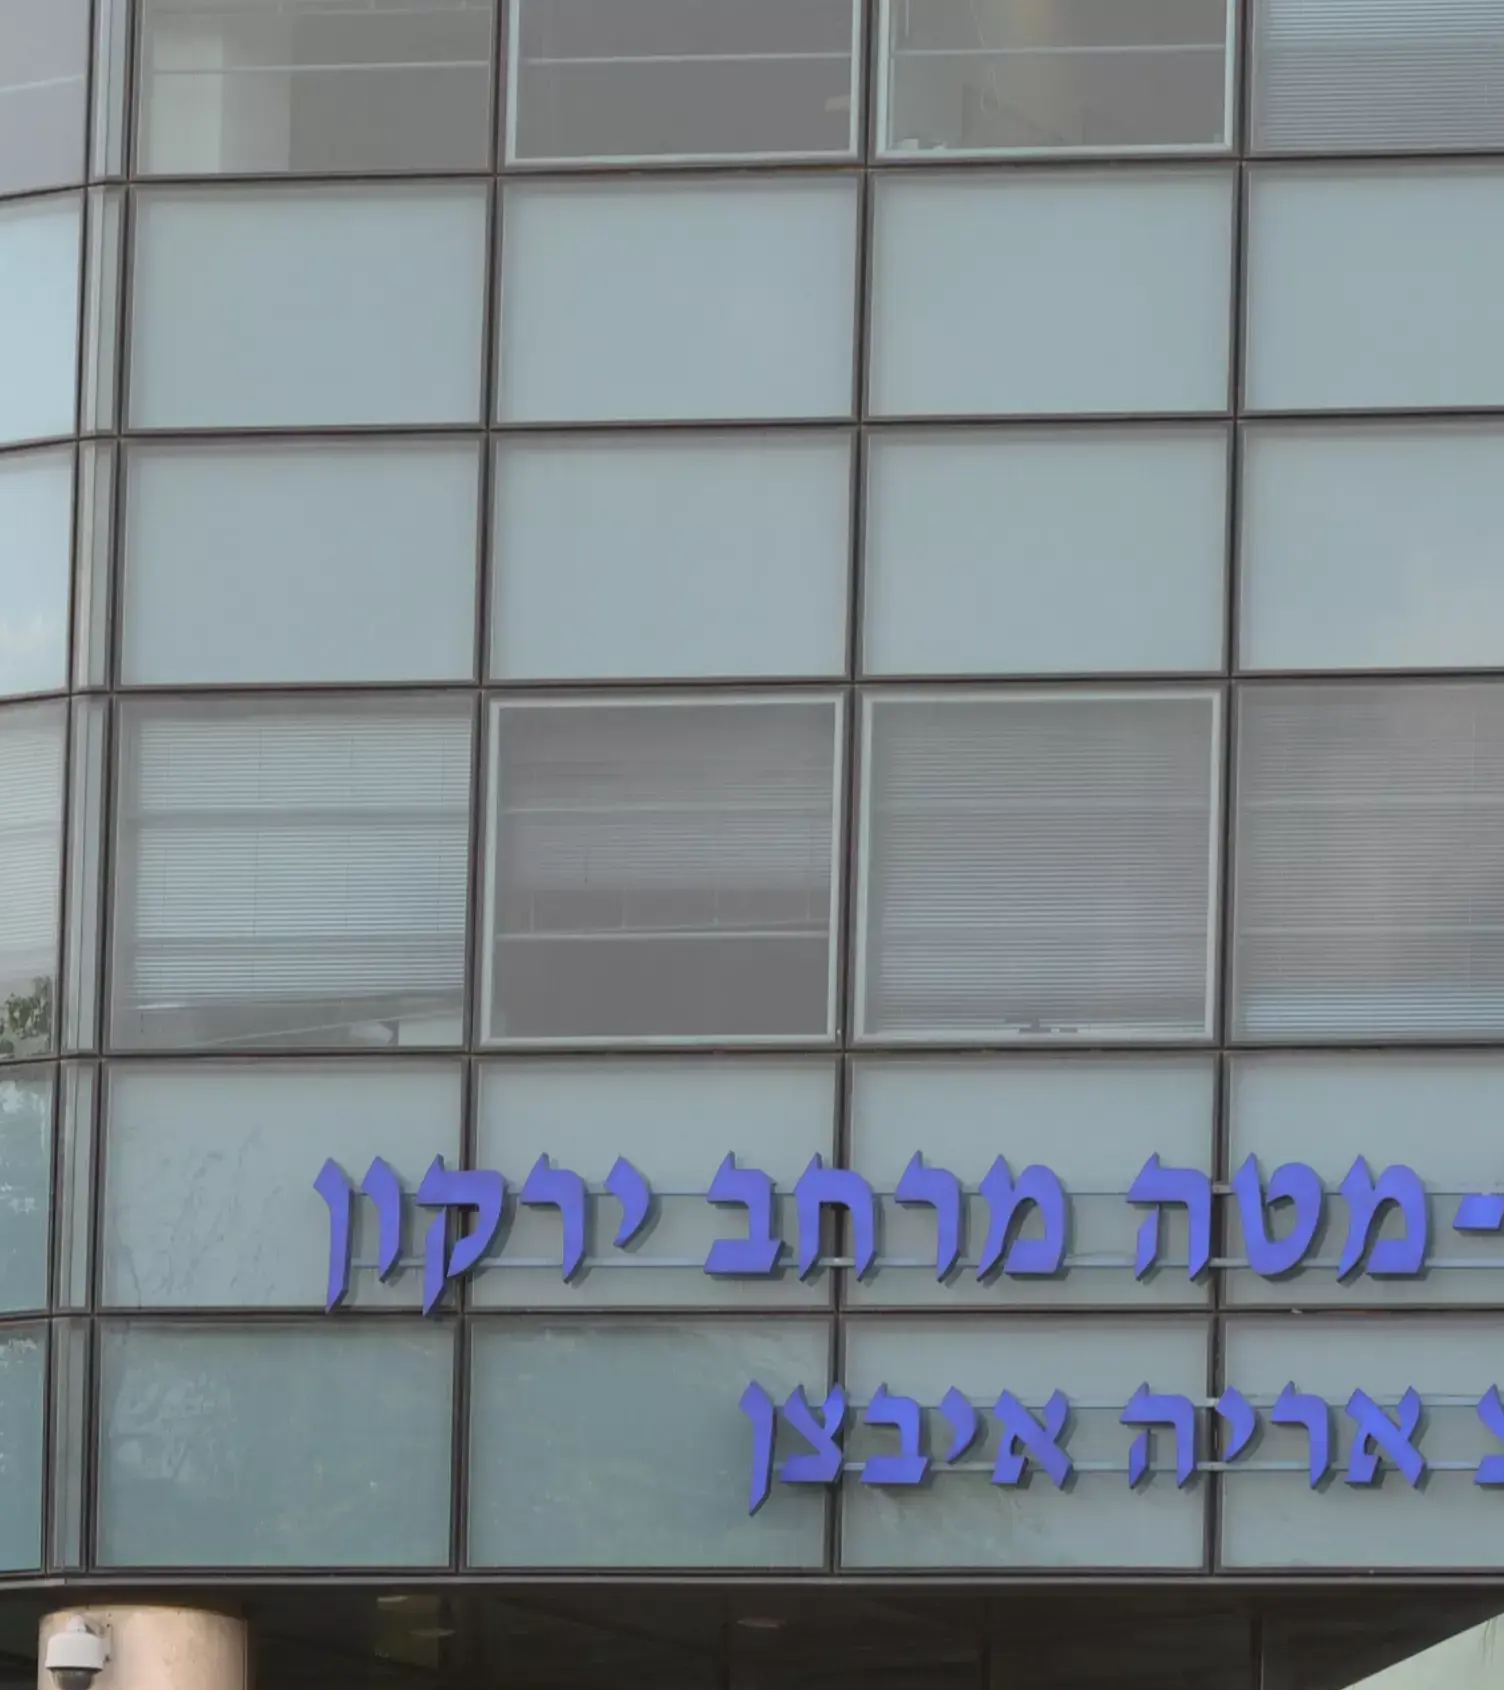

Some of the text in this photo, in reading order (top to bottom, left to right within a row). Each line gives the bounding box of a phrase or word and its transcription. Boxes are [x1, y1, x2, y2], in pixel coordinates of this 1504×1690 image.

[312, 1156, 654, 1314] ירקון
[703, 1154, 1069, 1282] מרחב
[739, 1381, 1074, 1513] איבצן
[1120, 1383, 1428, 1489] אריה
